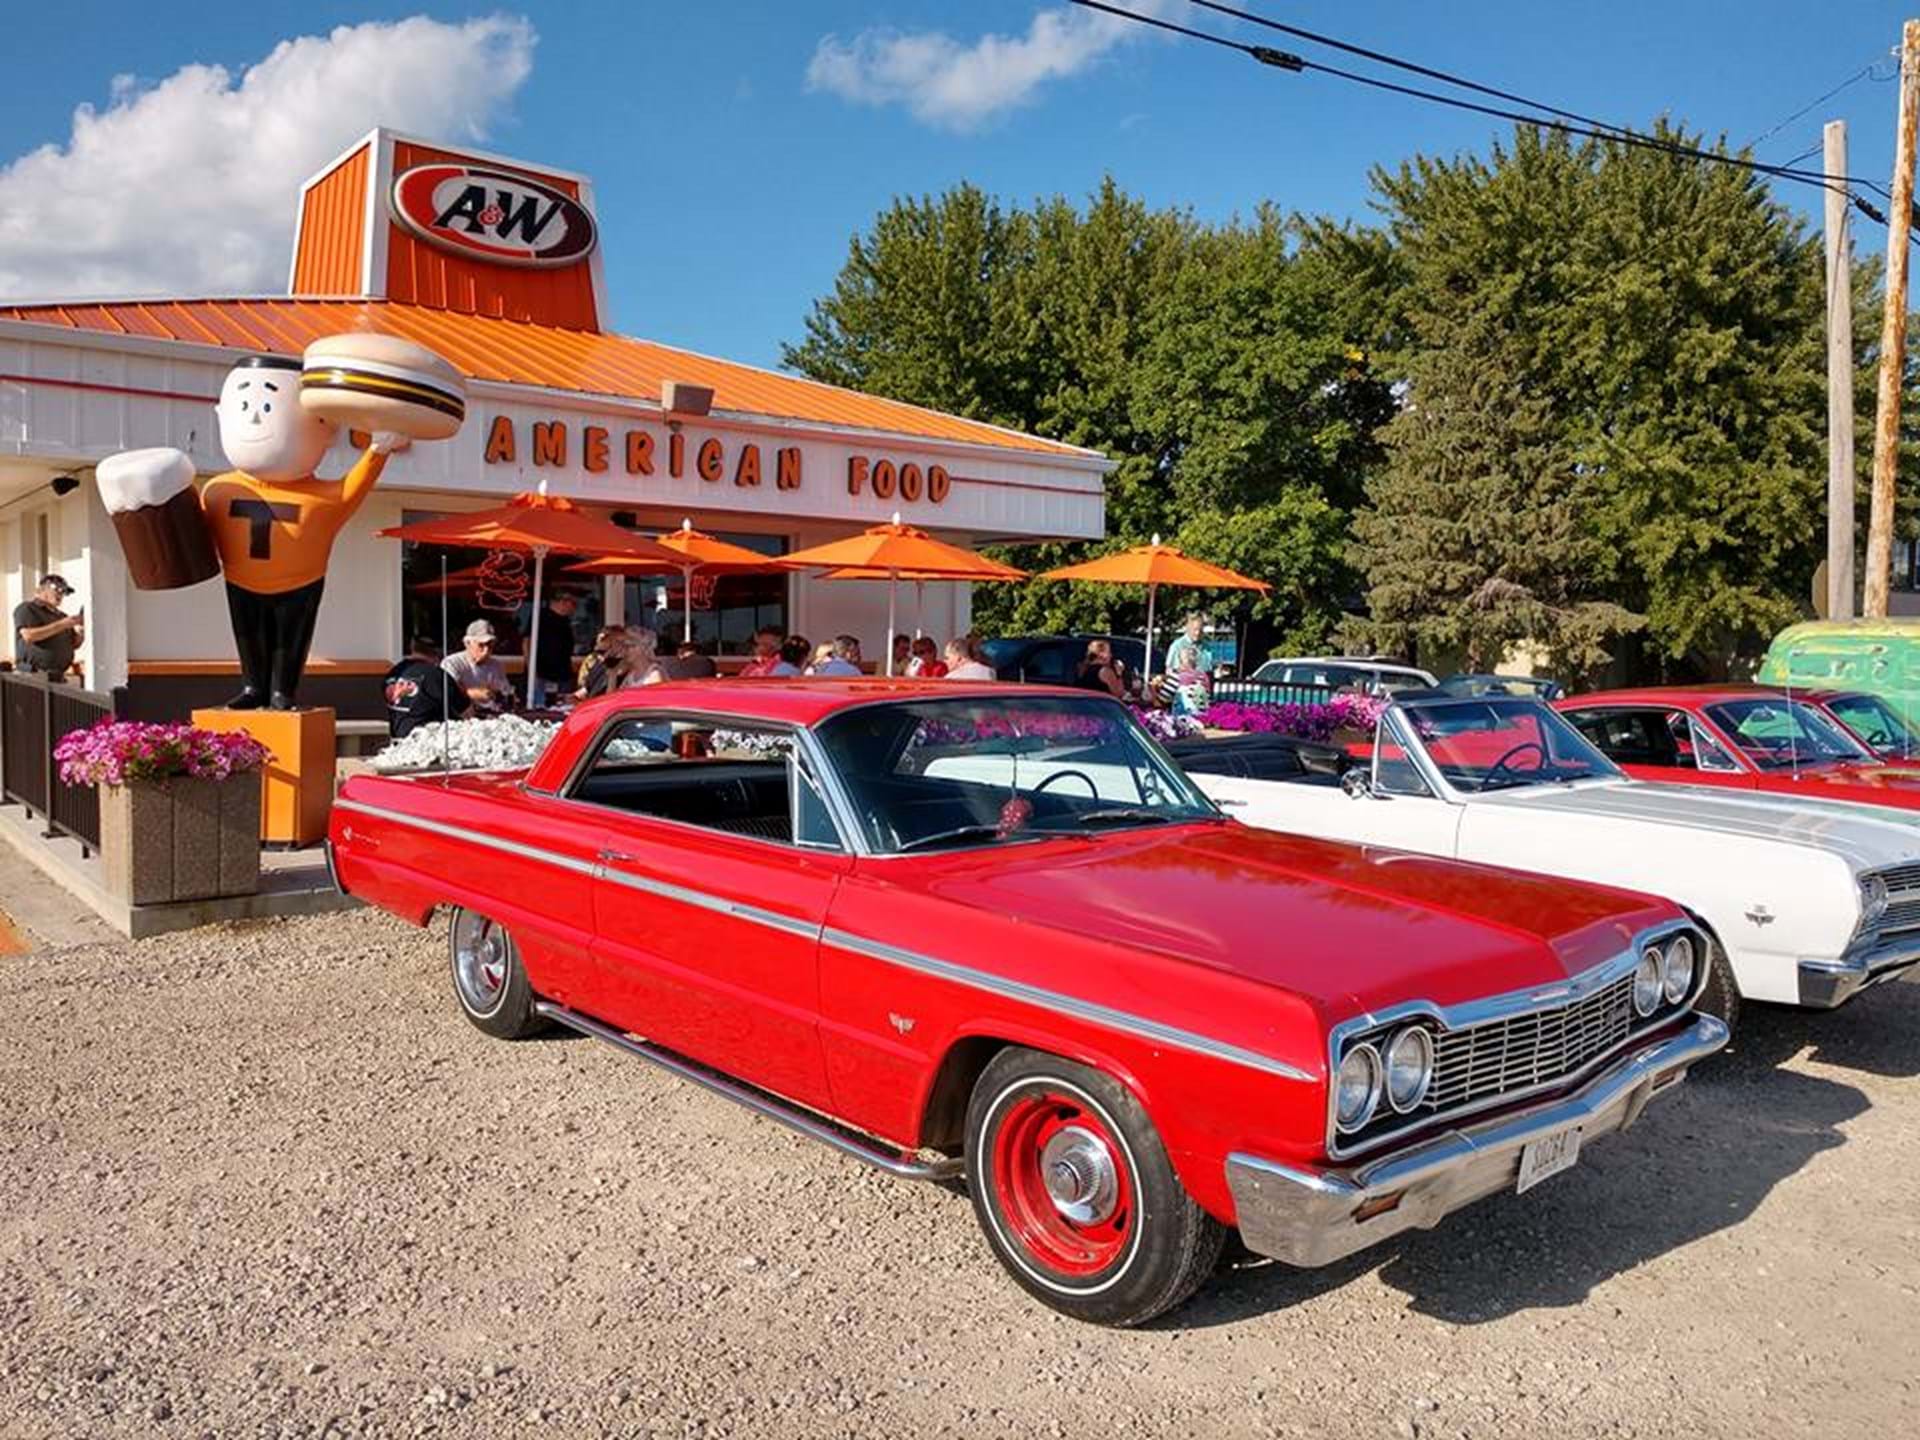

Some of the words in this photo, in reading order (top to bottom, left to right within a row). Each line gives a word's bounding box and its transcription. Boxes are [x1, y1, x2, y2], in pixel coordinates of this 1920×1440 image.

[432, 184, 562, 244] A&W
[485, 415, 801, 491] AMERICAN
[847, 456, 950, 503] FOOD
[230, 499, 302, 560] T
